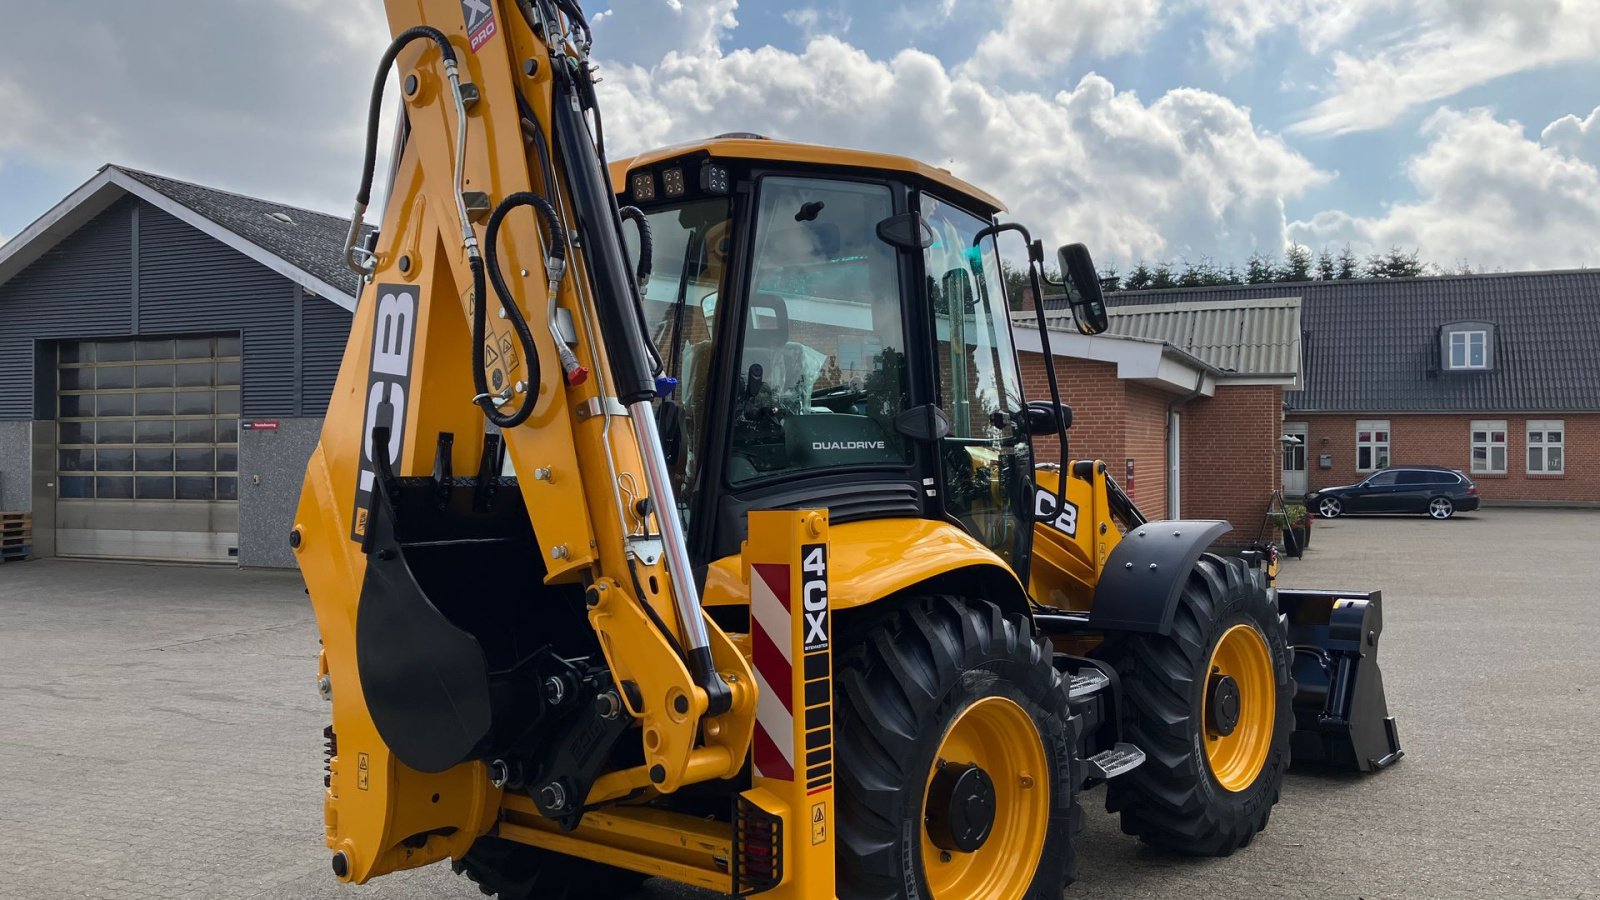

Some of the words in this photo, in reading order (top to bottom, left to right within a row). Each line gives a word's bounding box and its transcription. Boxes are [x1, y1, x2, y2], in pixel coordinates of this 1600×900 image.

[471, 21, 495, 50] PRO
[812, 441, 885, 450] DUALDRIVE
[1034, 489, 1077, 535] CB
[803, 547, 828, 644] 4CX
